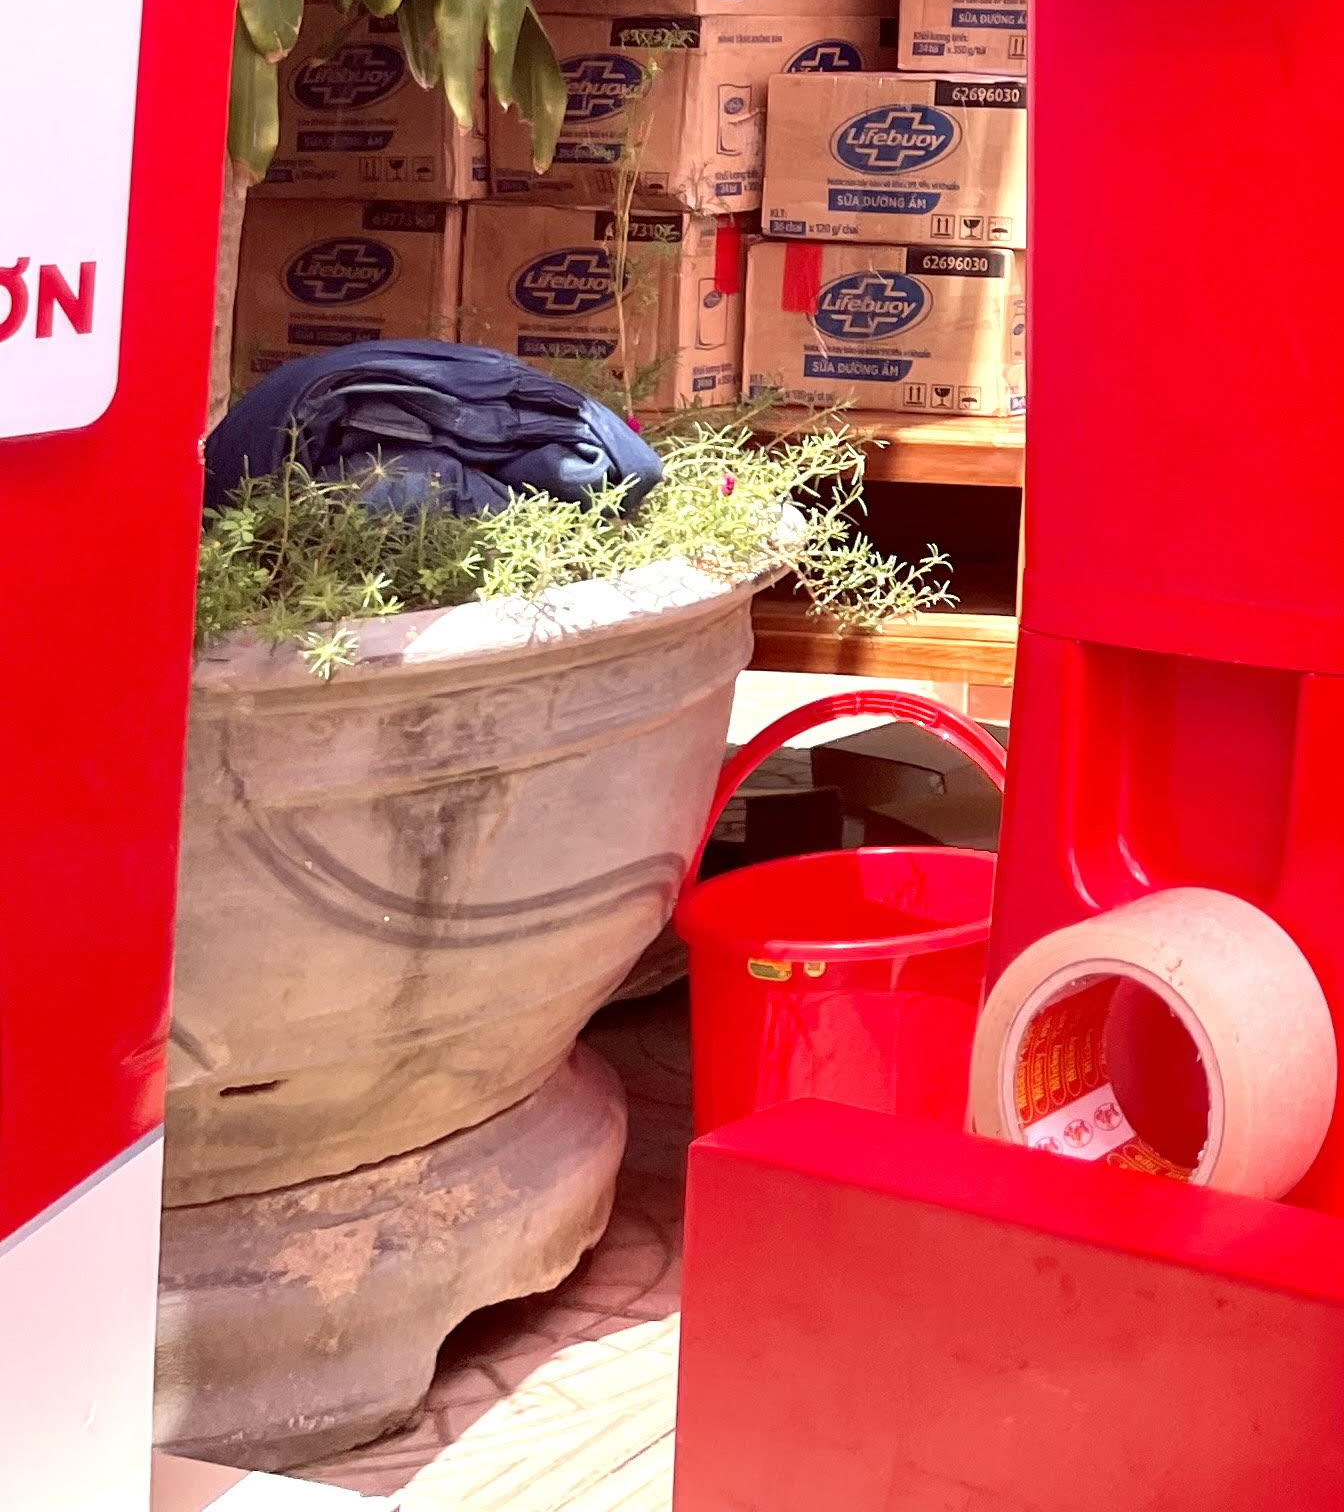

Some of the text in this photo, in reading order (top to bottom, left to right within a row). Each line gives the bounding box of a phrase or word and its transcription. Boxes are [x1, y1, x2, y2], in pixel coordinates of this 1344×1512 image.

[951, 86, 1020, 103] 62696030
[846, 127, 946, 151] Lifebuoy
[296, 260, 387, 283] Lifebuoy
[922, 255, 988, 272] 62696030
[821, 292, 916, 318] Lifebuoy
[811, 360, 835, 373] SỮA
